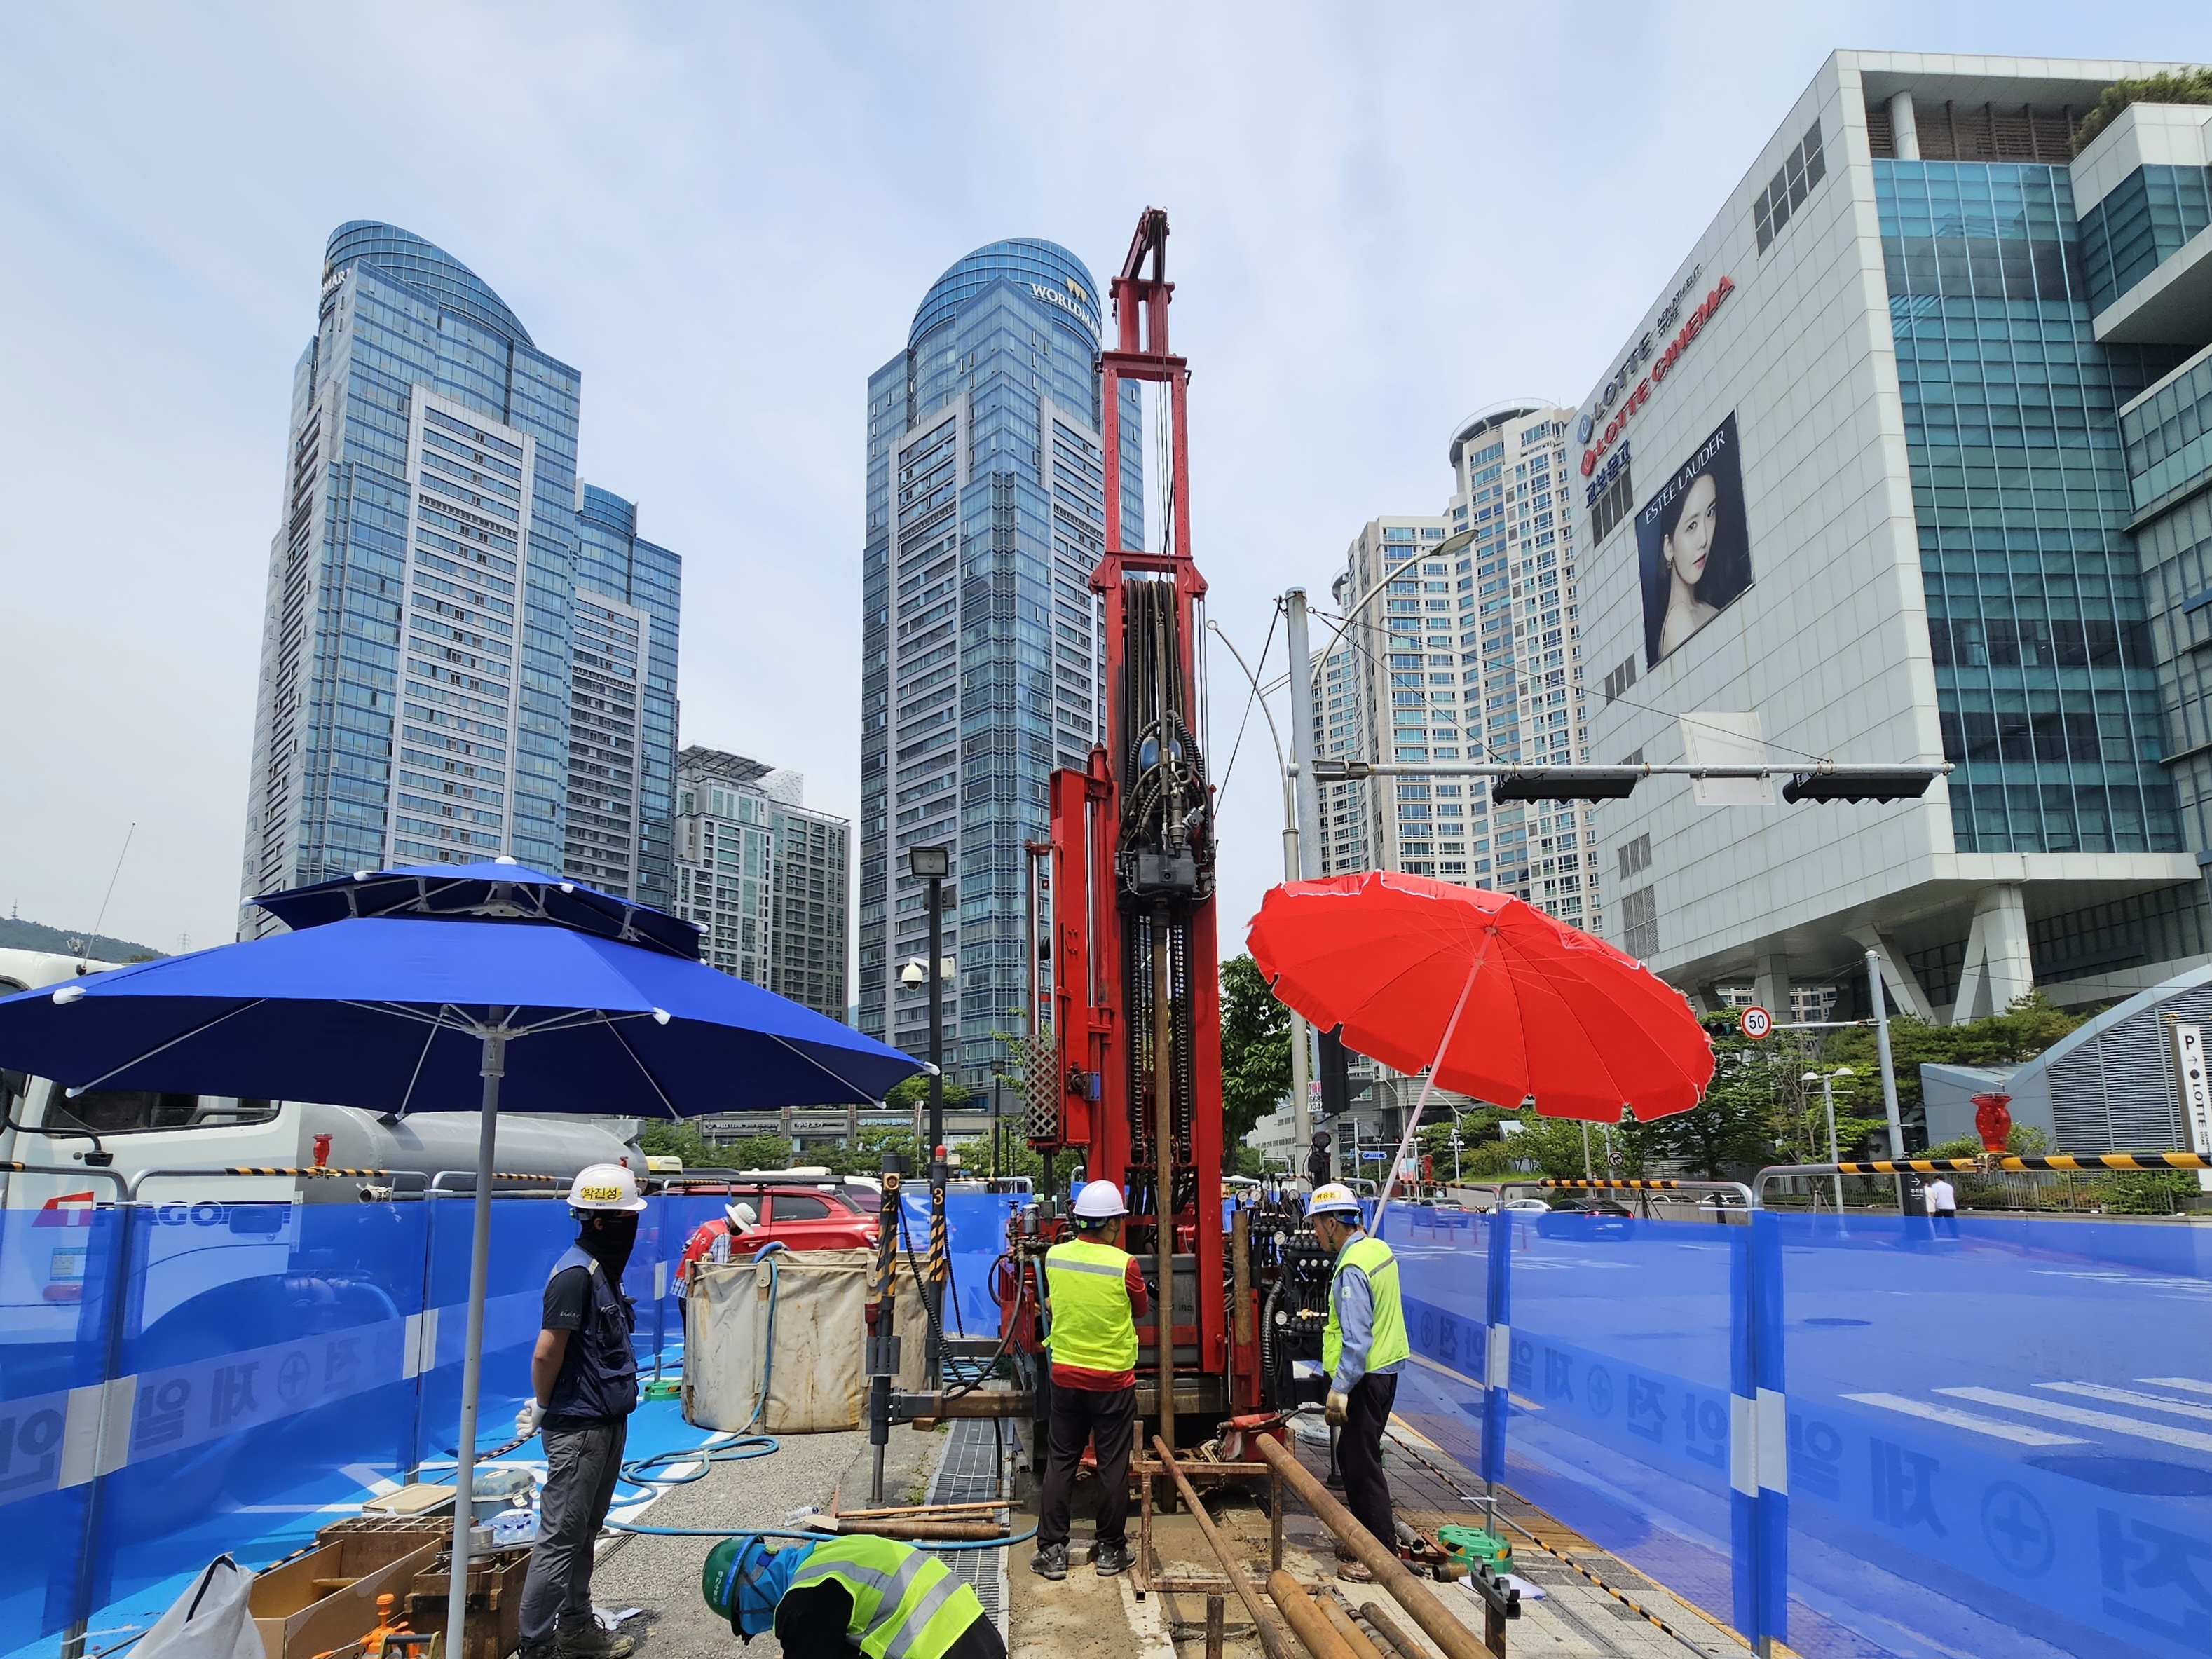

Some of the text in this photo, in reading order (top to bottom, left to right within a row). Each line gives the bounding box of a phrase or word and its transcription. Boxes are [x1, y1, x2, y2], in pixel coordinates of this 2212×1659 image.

[1594, 332, 1651, 420] LOTTE
[1596, 275, 1735, 456] LOTTE CINEMA
[1585, 439, 1631, 509] 교보문고
[1678, 430, 1726, 490] LAUDER
[1749, 1015, 1765, 1029] 50
[2185, 1035, 2194, 1050] P
[2192, 1084, 2207, 1128] LOTTE
[934, 1187, 943, 1205] 3
